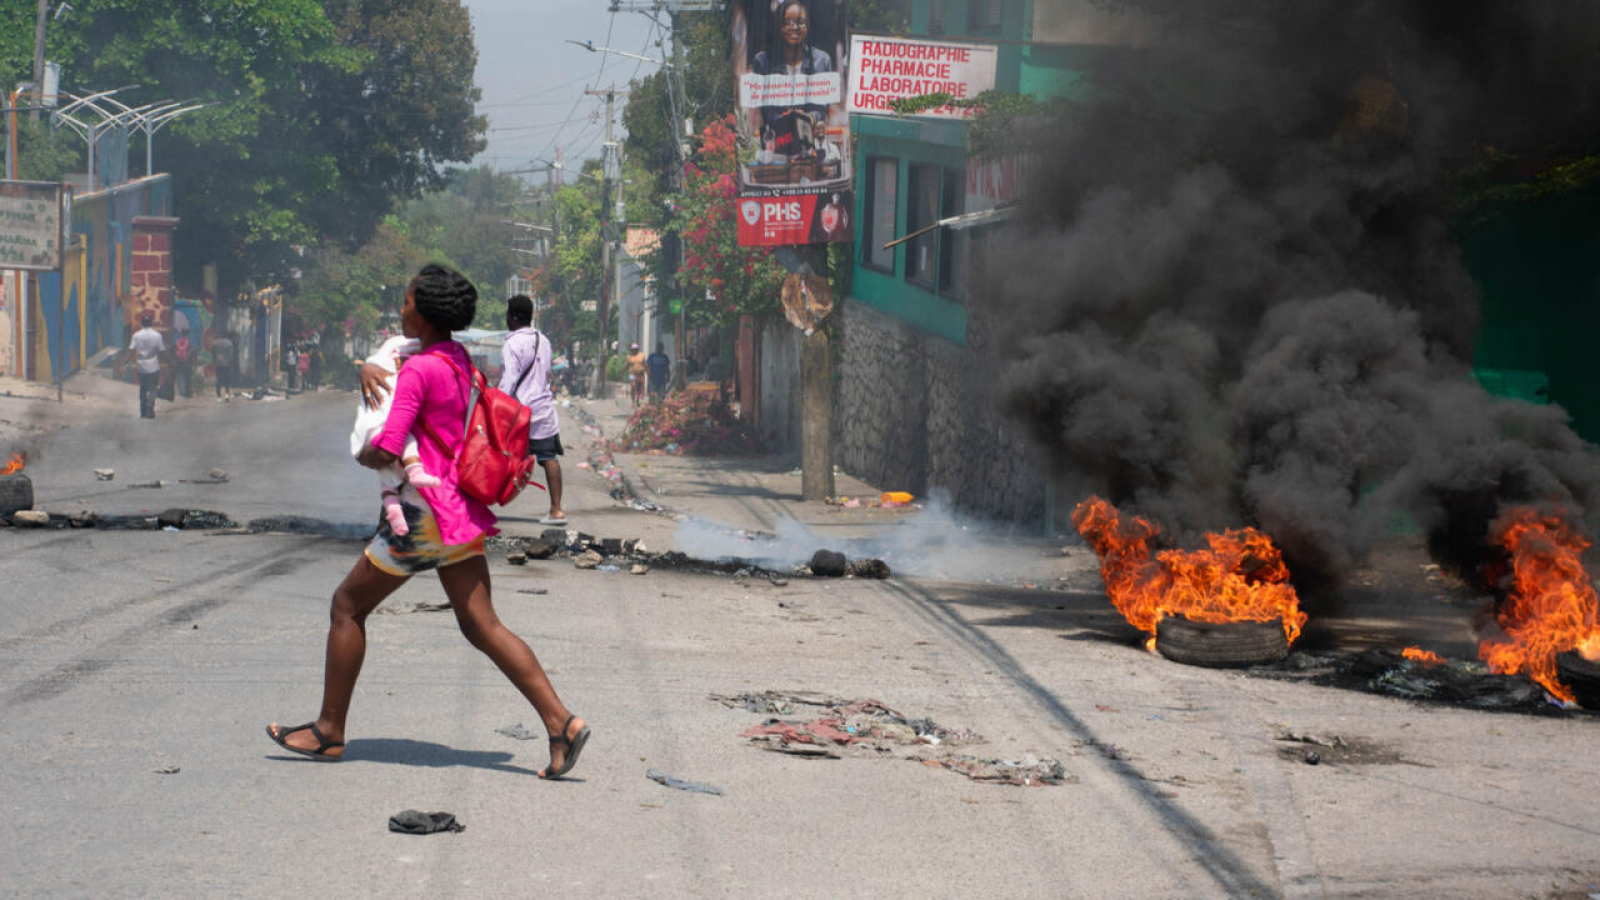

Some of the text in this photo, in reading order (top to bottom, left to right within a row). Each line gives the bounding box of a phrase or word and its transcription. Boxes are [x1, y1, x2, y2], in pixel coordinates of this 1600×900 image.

[862, 40, 970, 62] RADIOGRAPHIE
[860, 58, 950, 79] PHARMACIE
[859, 75, 968, 98] LABORATOIRE
[764, 202, 801, 221] PHS
